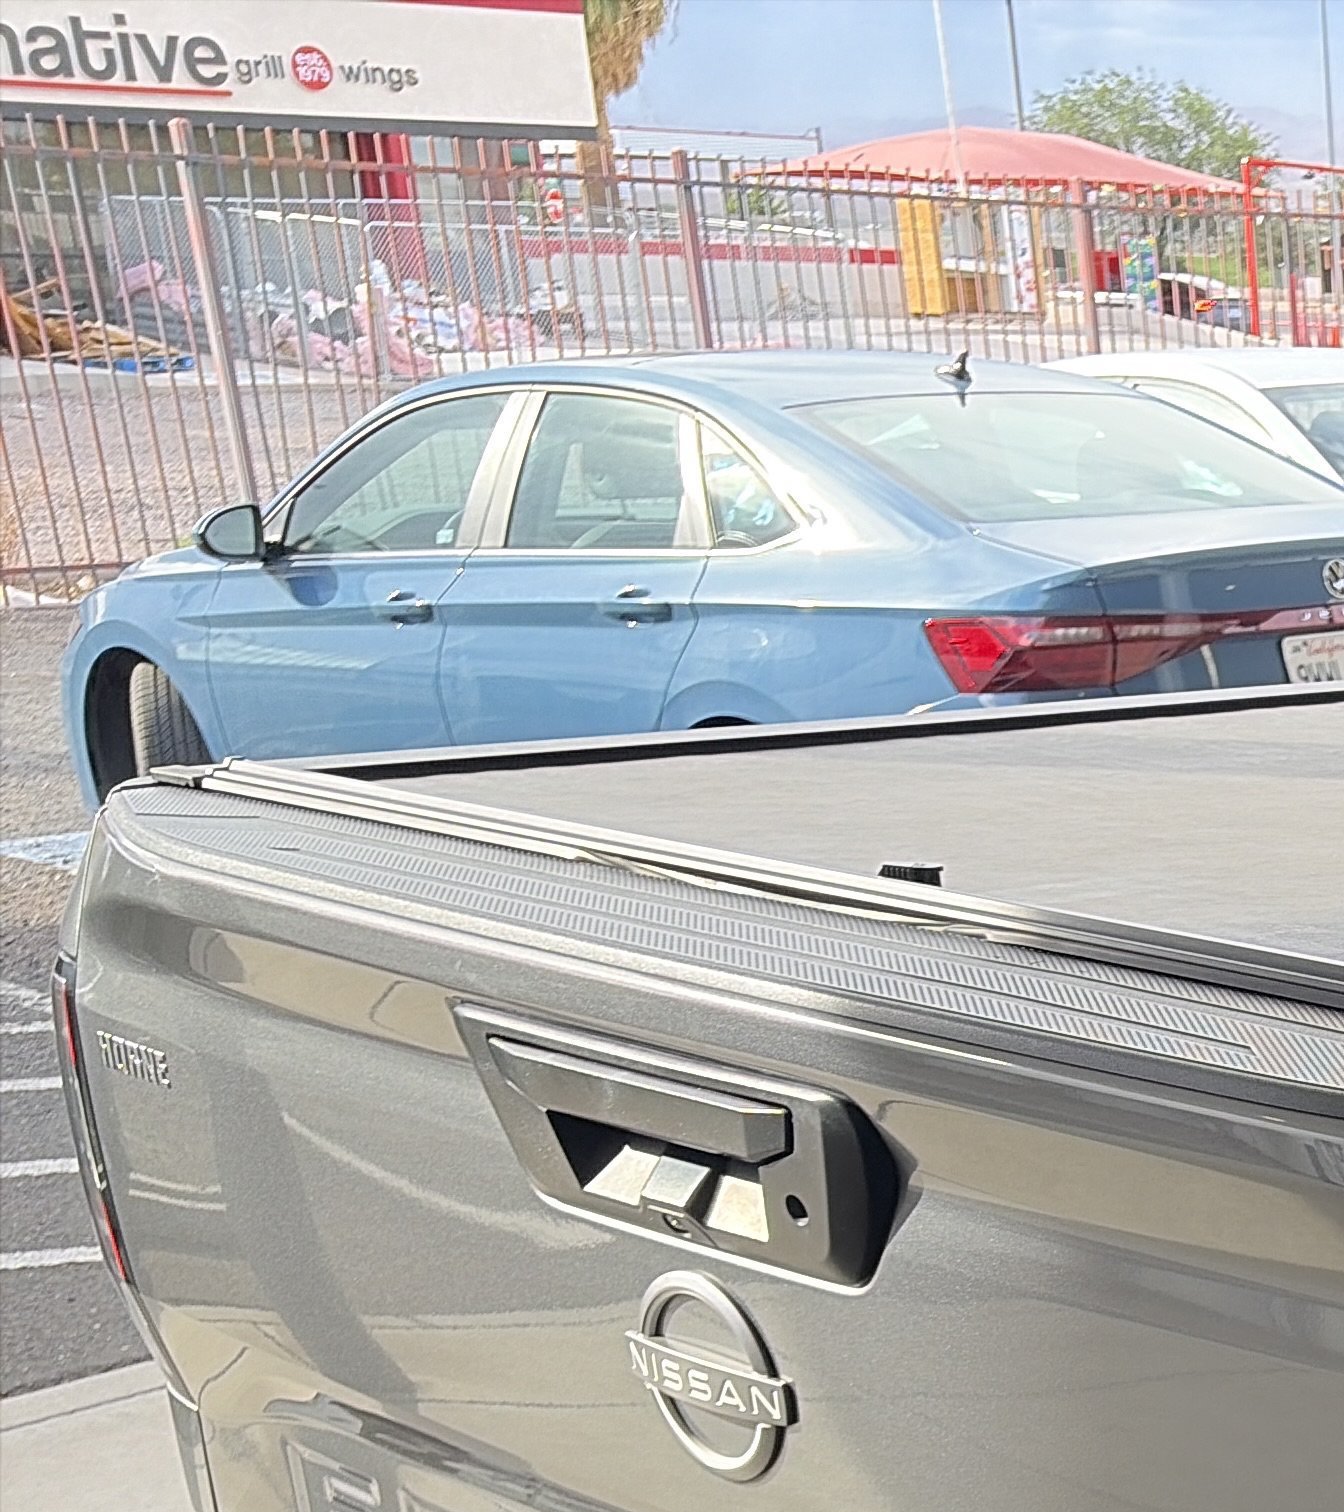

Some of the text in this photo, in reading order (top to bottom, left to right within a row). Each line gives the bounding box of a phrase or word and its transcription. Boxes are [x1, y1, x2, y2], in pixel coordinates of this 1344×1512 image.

[235, 54, 286, 85] grill
[339, 59, 419, 92] wings
[97, 1030, 170, 1085] HORNE
[628, 1341, 782, 1420] NISSAN
